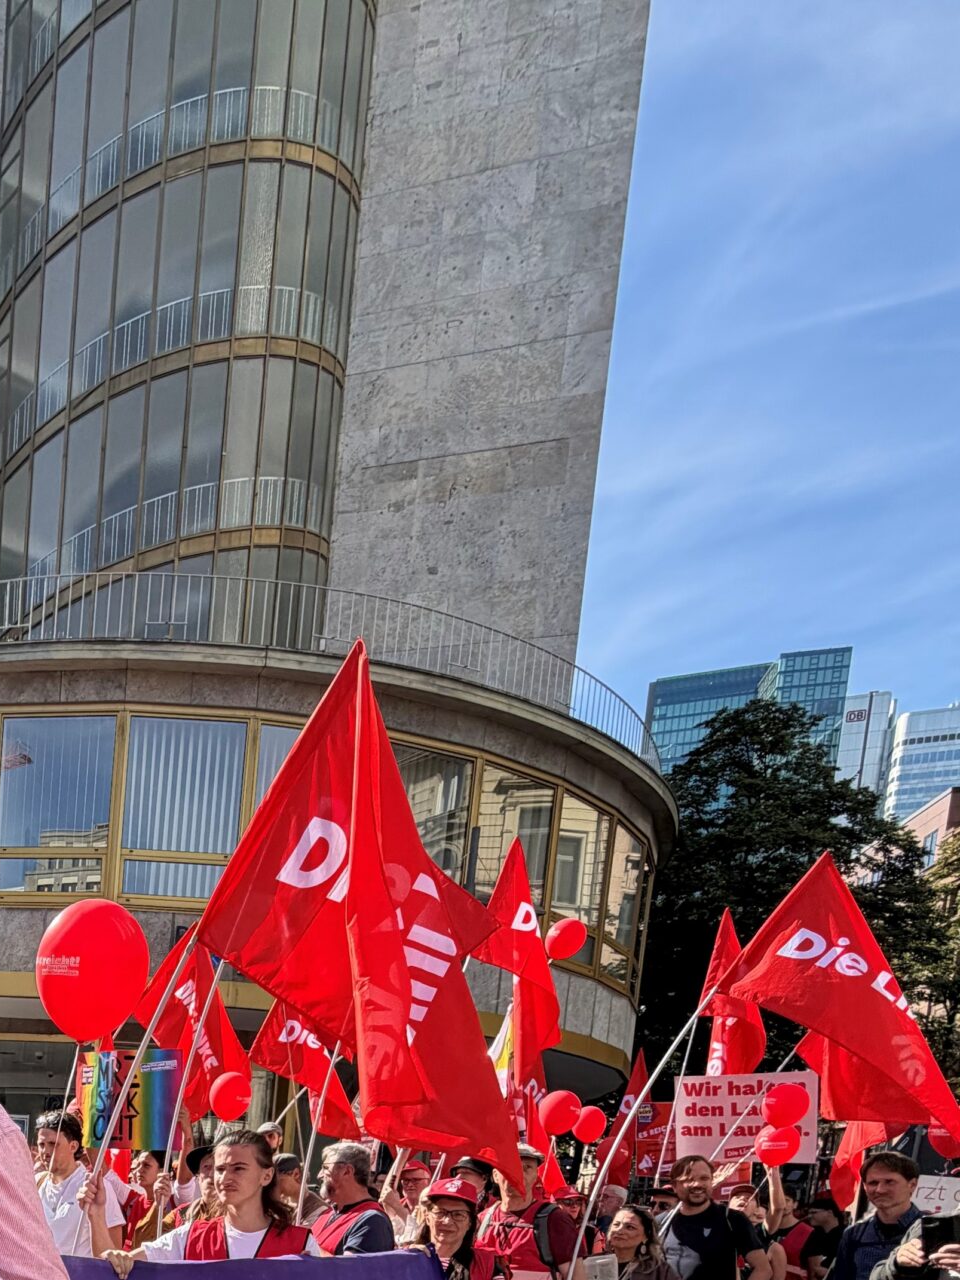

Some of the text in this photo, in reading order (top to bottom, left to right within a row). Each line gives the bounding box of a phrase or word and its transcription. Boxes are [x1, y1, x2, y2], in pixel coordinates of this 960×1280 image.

[847, 712, 865, 722] DB
[776, 927, 869, 977] Die
[682, 1081, 722, 1097] Wir
[685, 1102, 724, 1117] den
[681, 1124, 713, 1137] am
